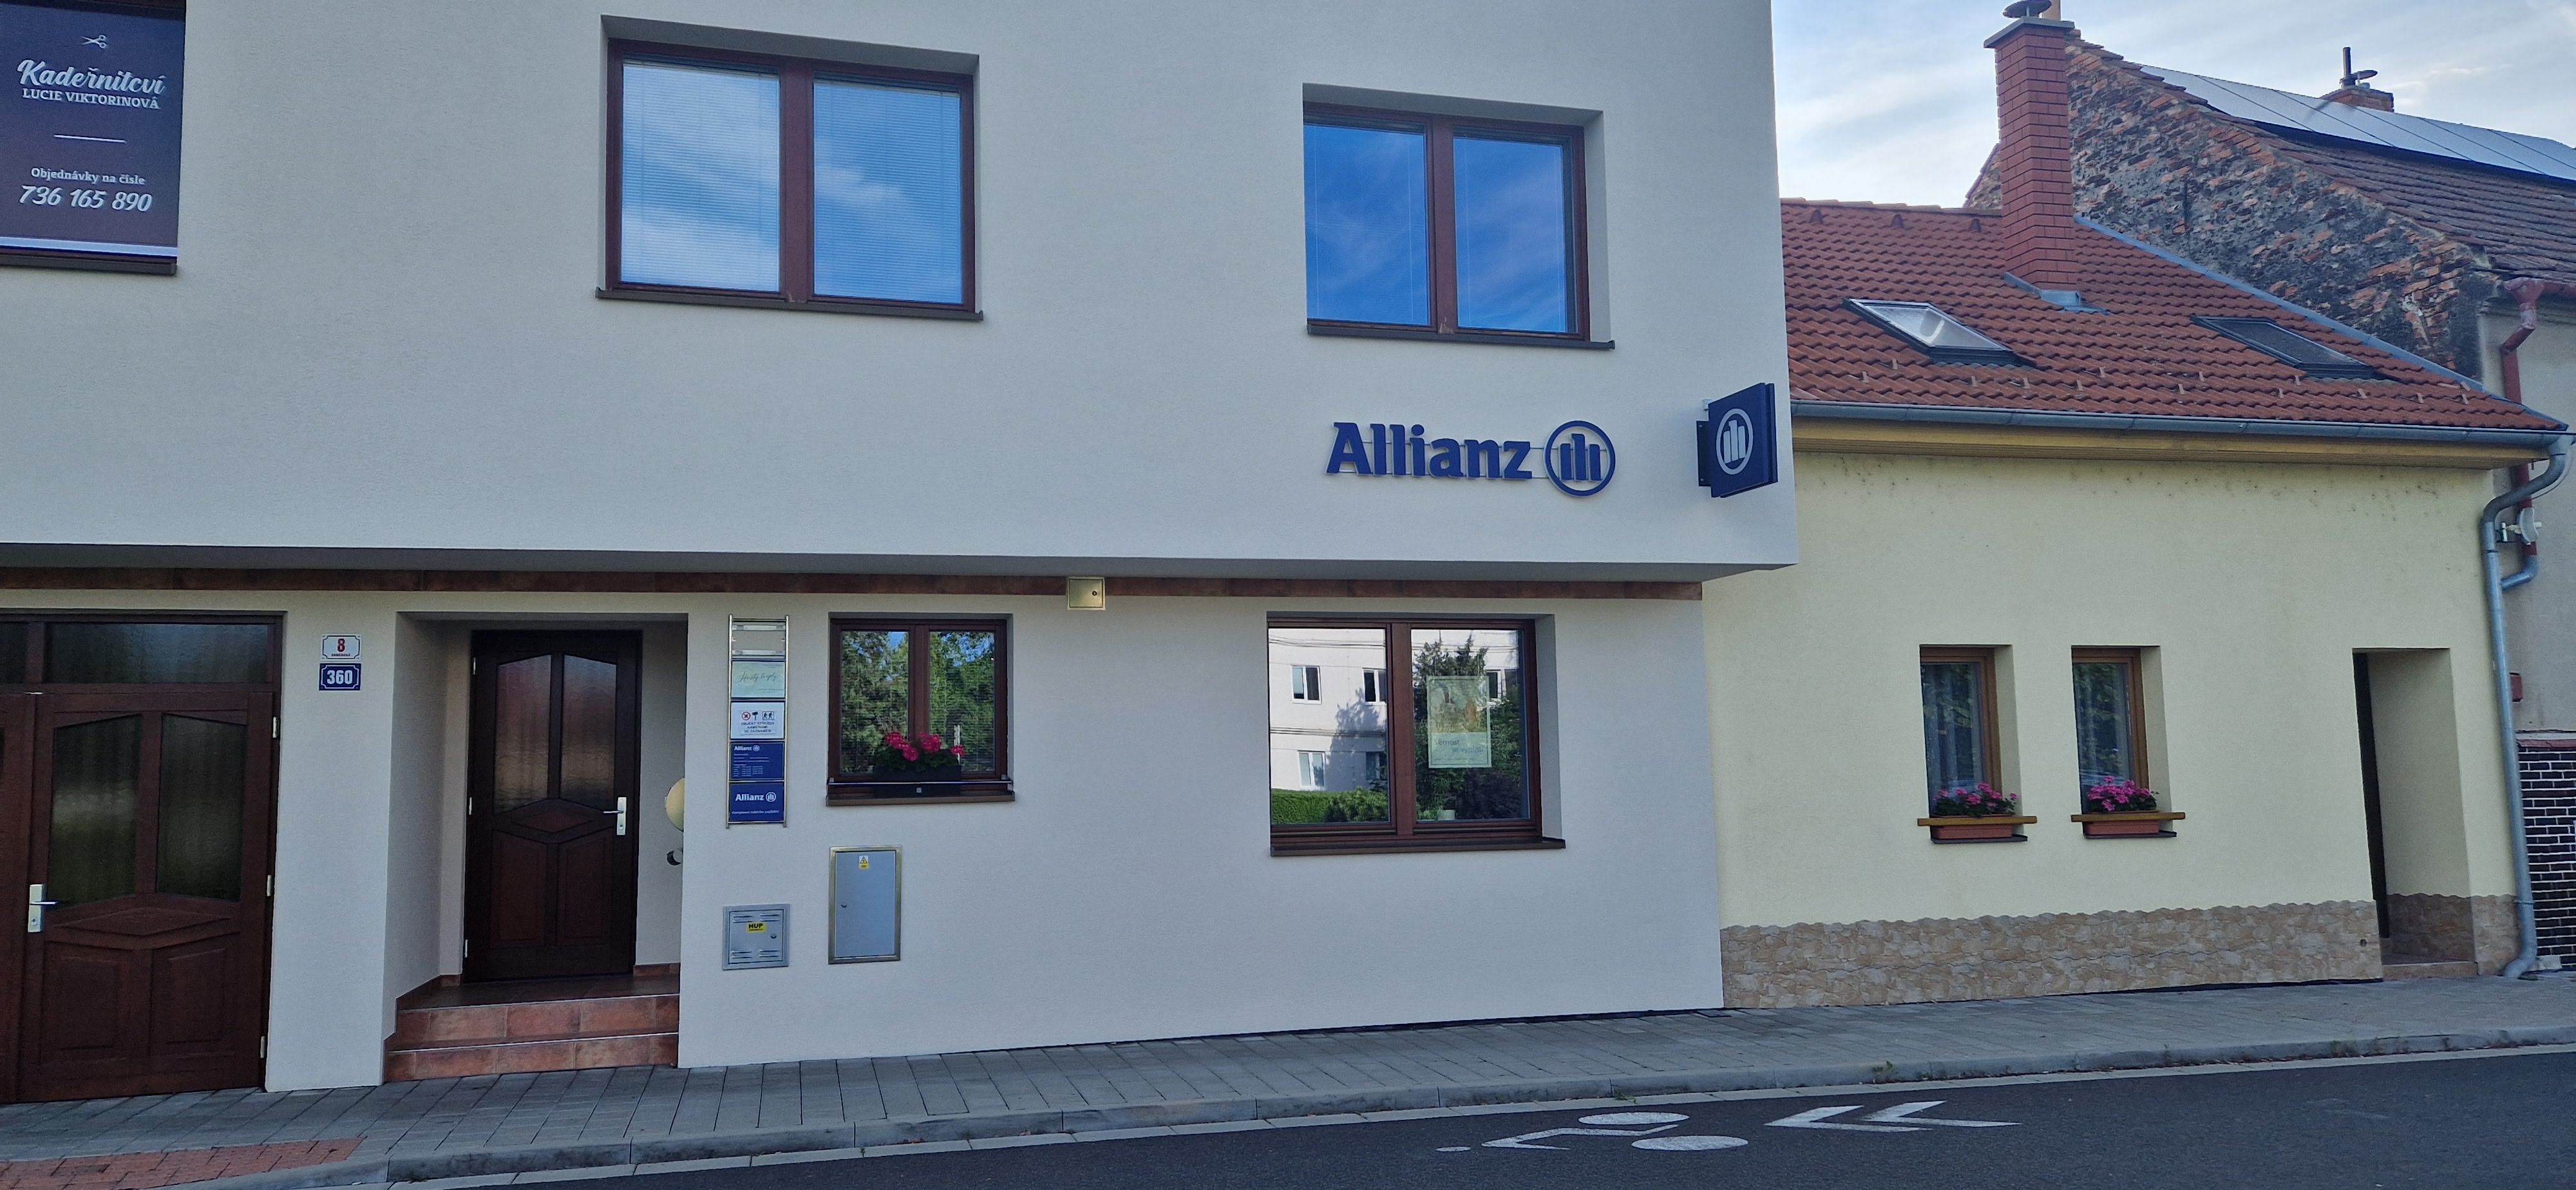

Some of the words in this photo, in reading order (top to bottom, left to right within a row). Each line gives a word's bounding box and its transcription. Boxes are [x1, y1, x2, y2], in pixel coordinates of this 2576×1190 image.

[17, 59, 167, 95] Kadeřnitcví
[23, 88, 62, 101] LUCIE
[65, 91, 160, 109] VIKTORINOVÁ
[31, 167, 99, 184] Objednávky
[102, 175, 117, 183] na
[118, 174, 146, 185] čísle
[19, 185, 63, 206] 736
[70, 189, 108, 209] 165
[111, 191, 152, 212] 890
[1325, 422, 1533, 480] Allianz
[337, 638, 345, 652] 8
[327, 670, 353, 685] 360
